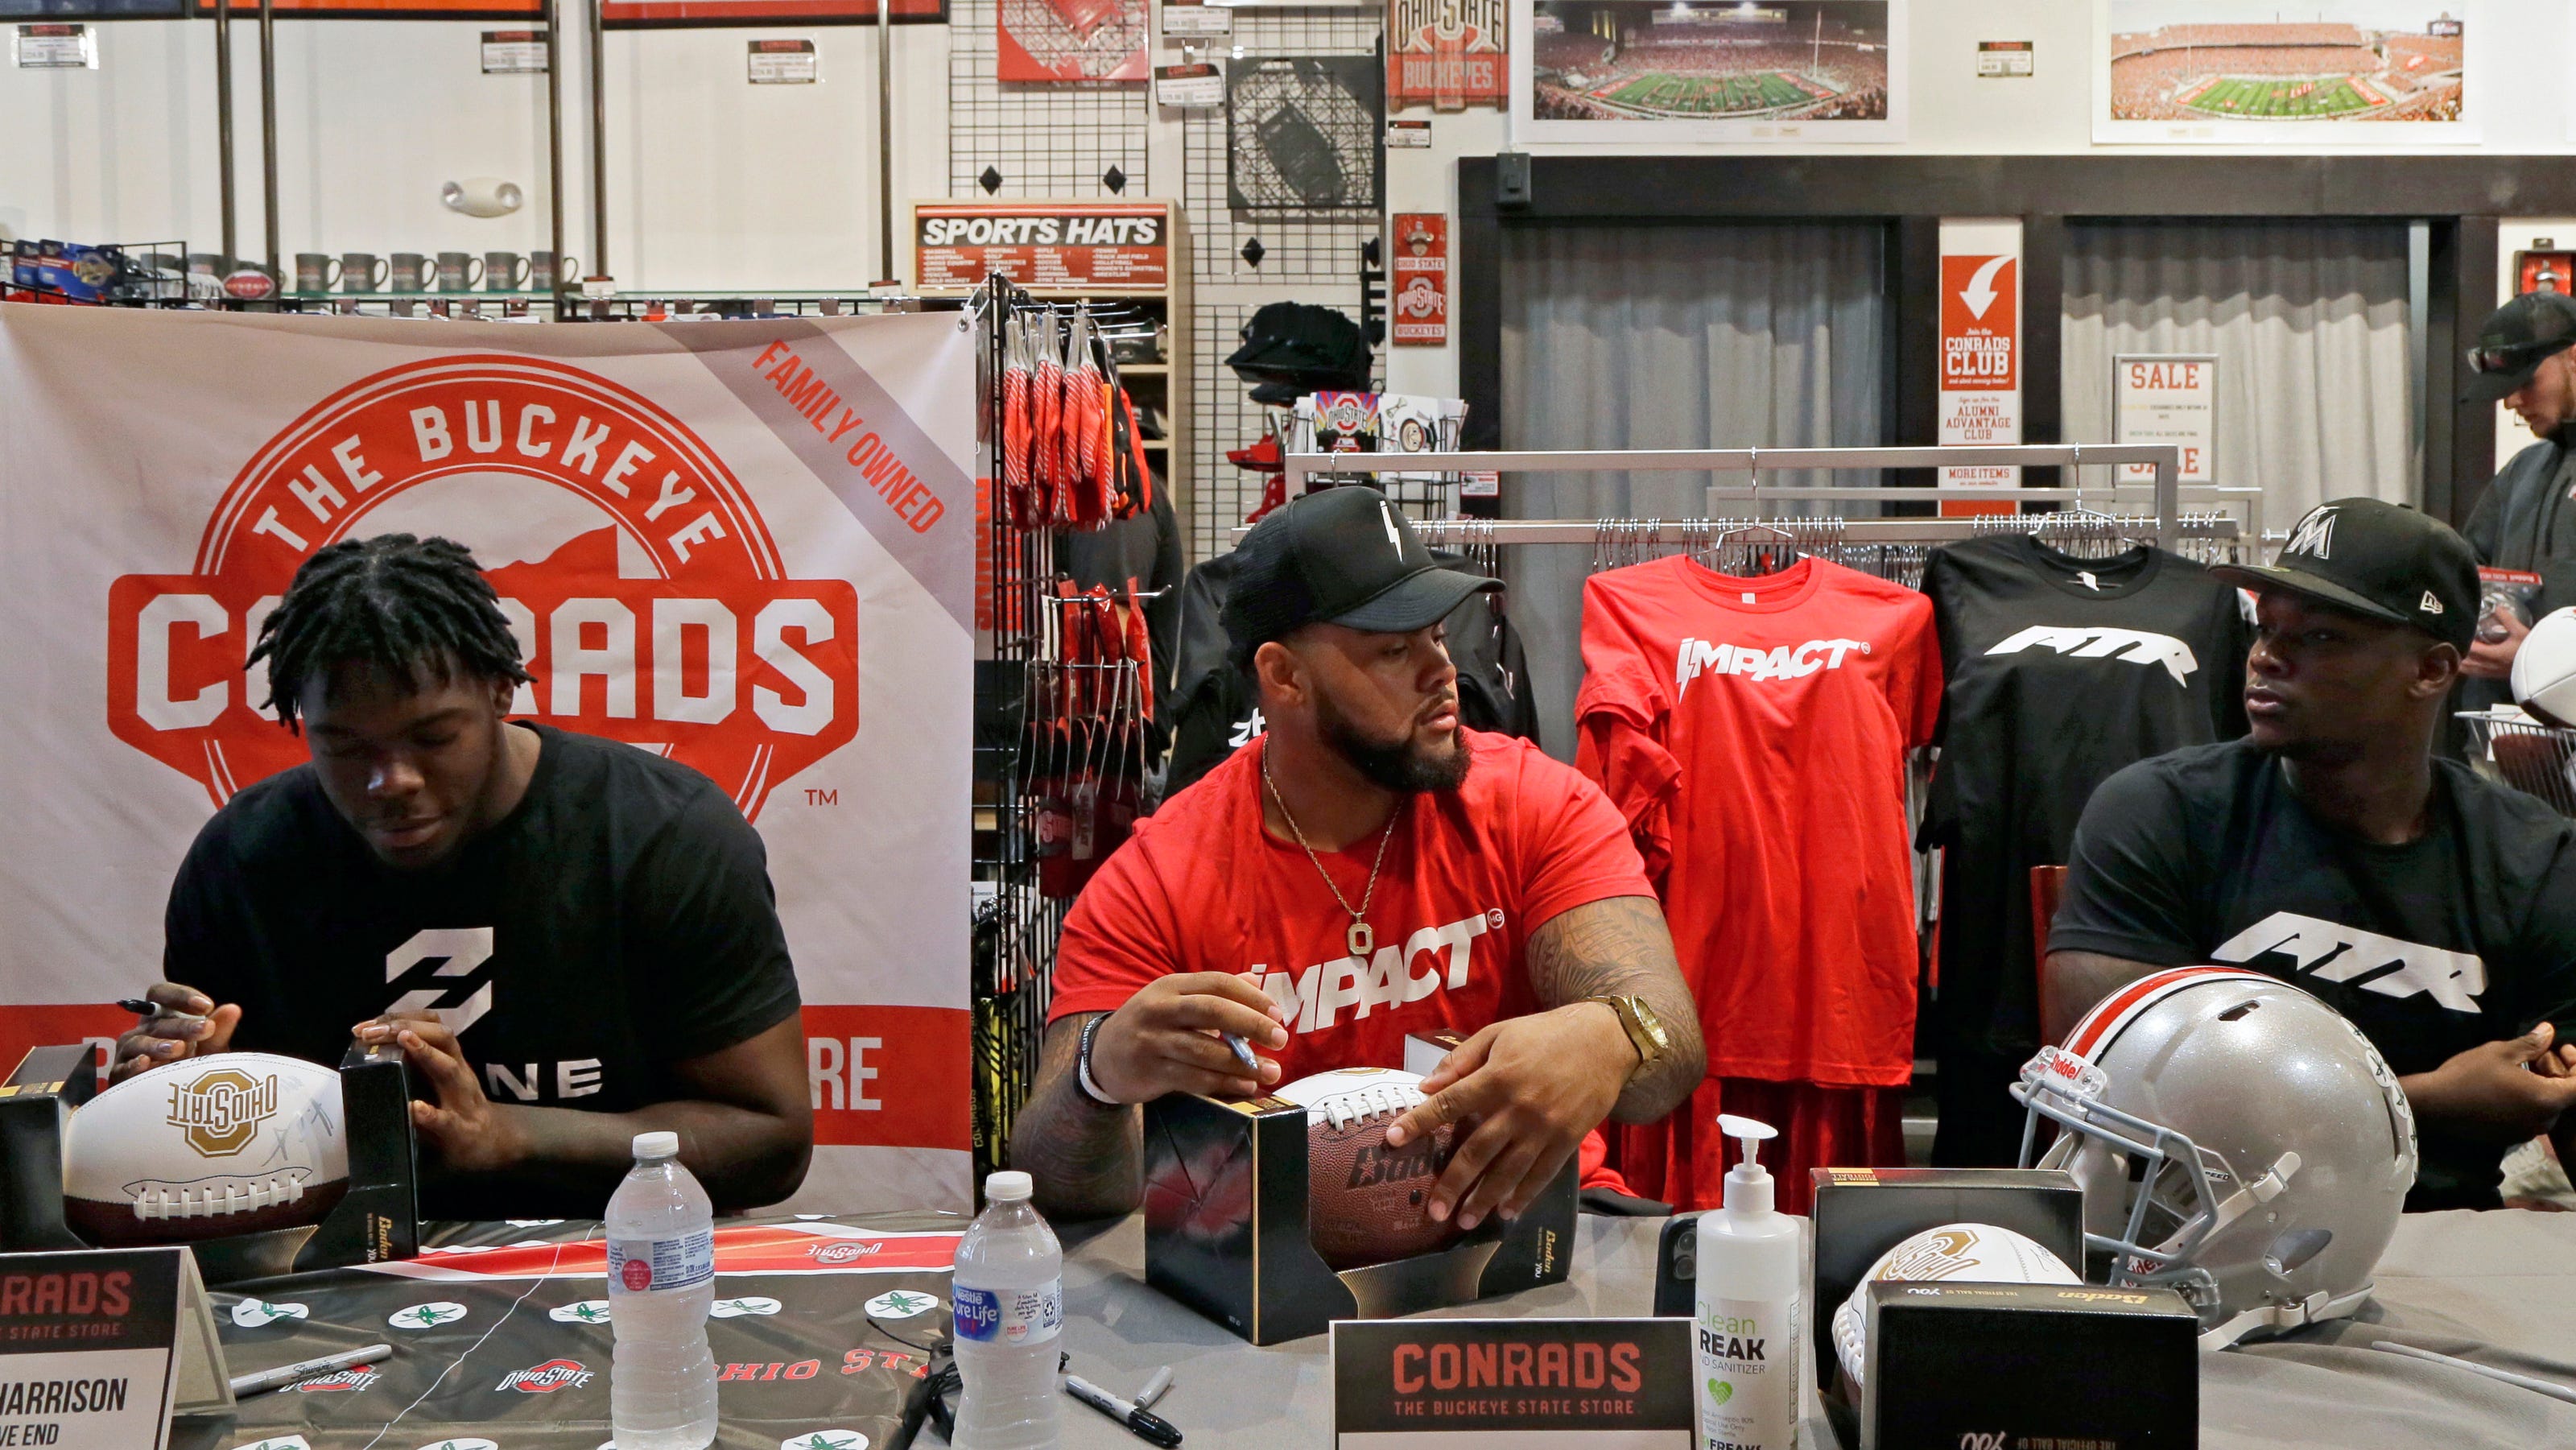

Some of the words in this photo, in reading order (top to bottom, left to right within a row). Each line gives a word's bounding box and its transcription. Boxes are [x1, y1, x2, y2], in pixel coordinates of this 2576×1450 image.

[1403, 61, 1493, 89] BUCKEYES
[923, 217, 1060, 246] SPORTS
[1065, 217, 1158, 245] HATS
[1418, 258, 1443, 269] STATE
[1397, 326, 1443, 336] BUCKEYES
[1981, 328, 1992, 336] the
[1946, 337, 2011, 352] CONRADS
[1946, 351, 2009, 376] CLUB
[2131, 363, 2199, 390] SALE
[1946, 418, 2011, 428] ADVANTAGE
[1958, 406, 2000, 416] ALUMNI
[753, 339, 863, 447] FAMILY
[846, 431, 946, 535] OWNED
[1964, 429, 1992, 440] CLUB
[252, 432, 384, 553] THE
[408, 399, 728, 564] BUCKEYE
[1949, 469, 1977, 479] MORE
[1979, 469, 2010, 479] ITEMS
[136, 593, 836, 737] CADS
[1984, 625, 2199, 689] ATR
[804, 789, 839, 806] TM
[2210, 911, 2489, 1014] ATR
[2205, 1171, 2230, 1181] PEED
[378, 1216, 392, 1260] Baden
[1544, 1229, 1556, 1273] Baden
[1534, 1262, 1543, 1279] YOU
[0, 1270, 131, 1316] RADS
[2057, 1291, 2149, 1305] Baden
[972, 1305, 998, 1327] Life
[1696, 1300, 1756, 1336] Clean
[9, 1325, 60, 1341] STATE
[69, 1323, 121, 1338] STORE
[1699, 1328, 1765, 1361] REAK
[714, 1358, 821, 1382] HIO
[1393, 1342, 1641, 1394] CONRADS
[1712, 1358, 1765, 1375] SANITIZER
[1393, 1400, 1426, 1417] THE
[1433, 1400, 1509, 1416] BUCKEYE
[1517, 1400, 1574, 1416] STATE
[1580, 1400, 1635, 1415] STORE
[23, 1423, 60, 1447] END
